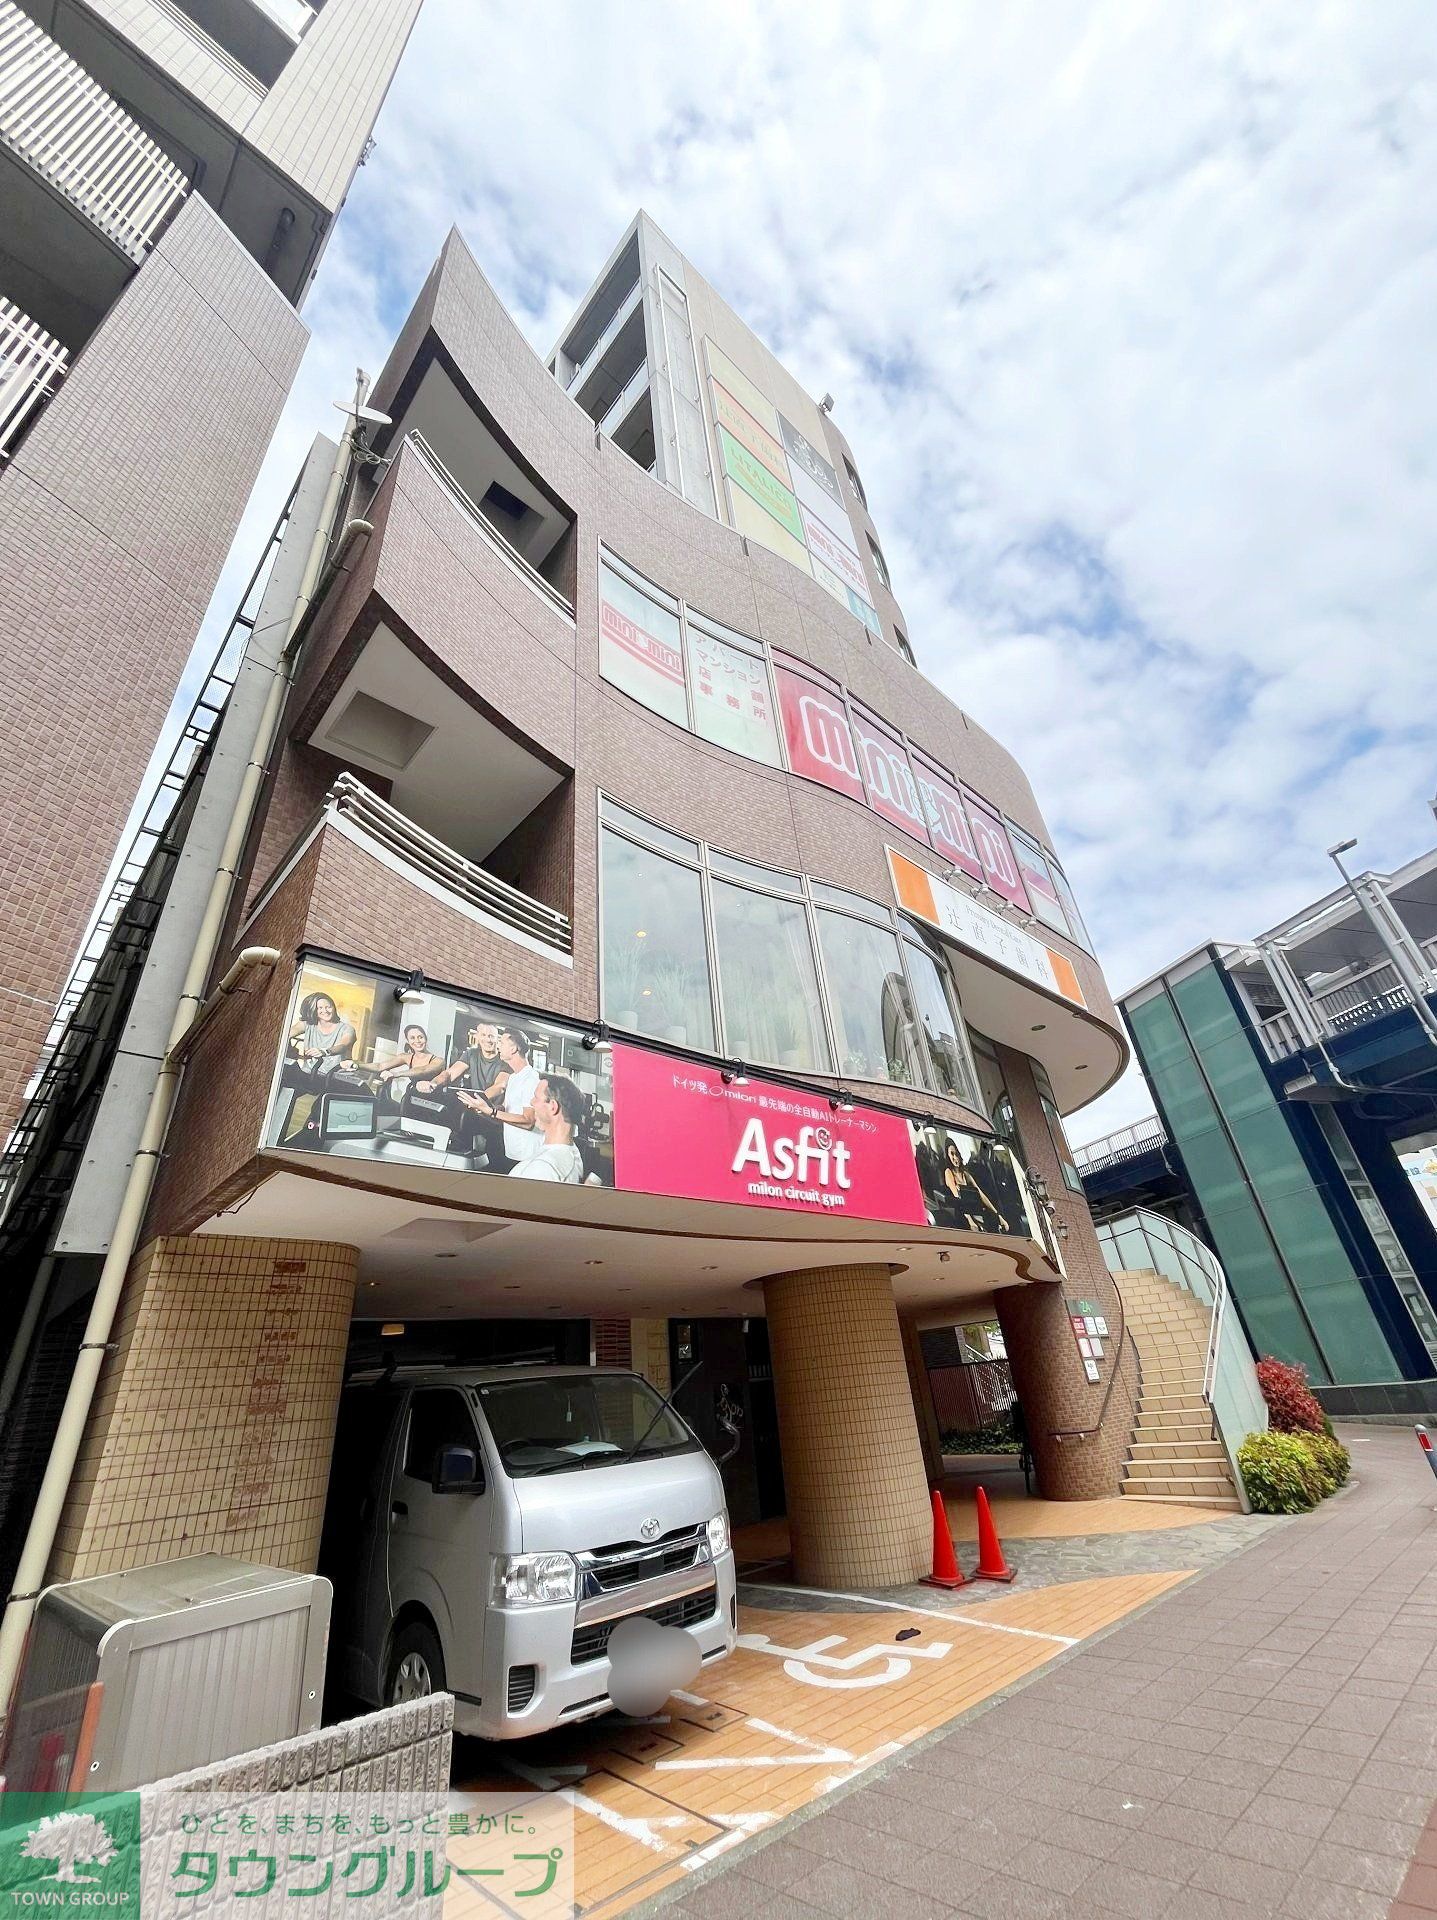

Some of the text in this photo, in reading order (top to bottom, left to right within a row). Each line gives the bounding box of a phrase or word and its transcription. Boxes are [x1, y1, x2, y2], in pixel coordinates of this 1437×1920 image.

[696, 633, 759, 670] アパート
[697, 649, 761, 685] マンション
[698, 681, 767, 720] 事務所
[672, 1074, 877, 1134] ドイツ発 milon 最先端の全自動AIトレーナーマシン
[731, 1117, 851, 1190] Asfit
[748, 1181, 845, 1208] milon circuit gym
